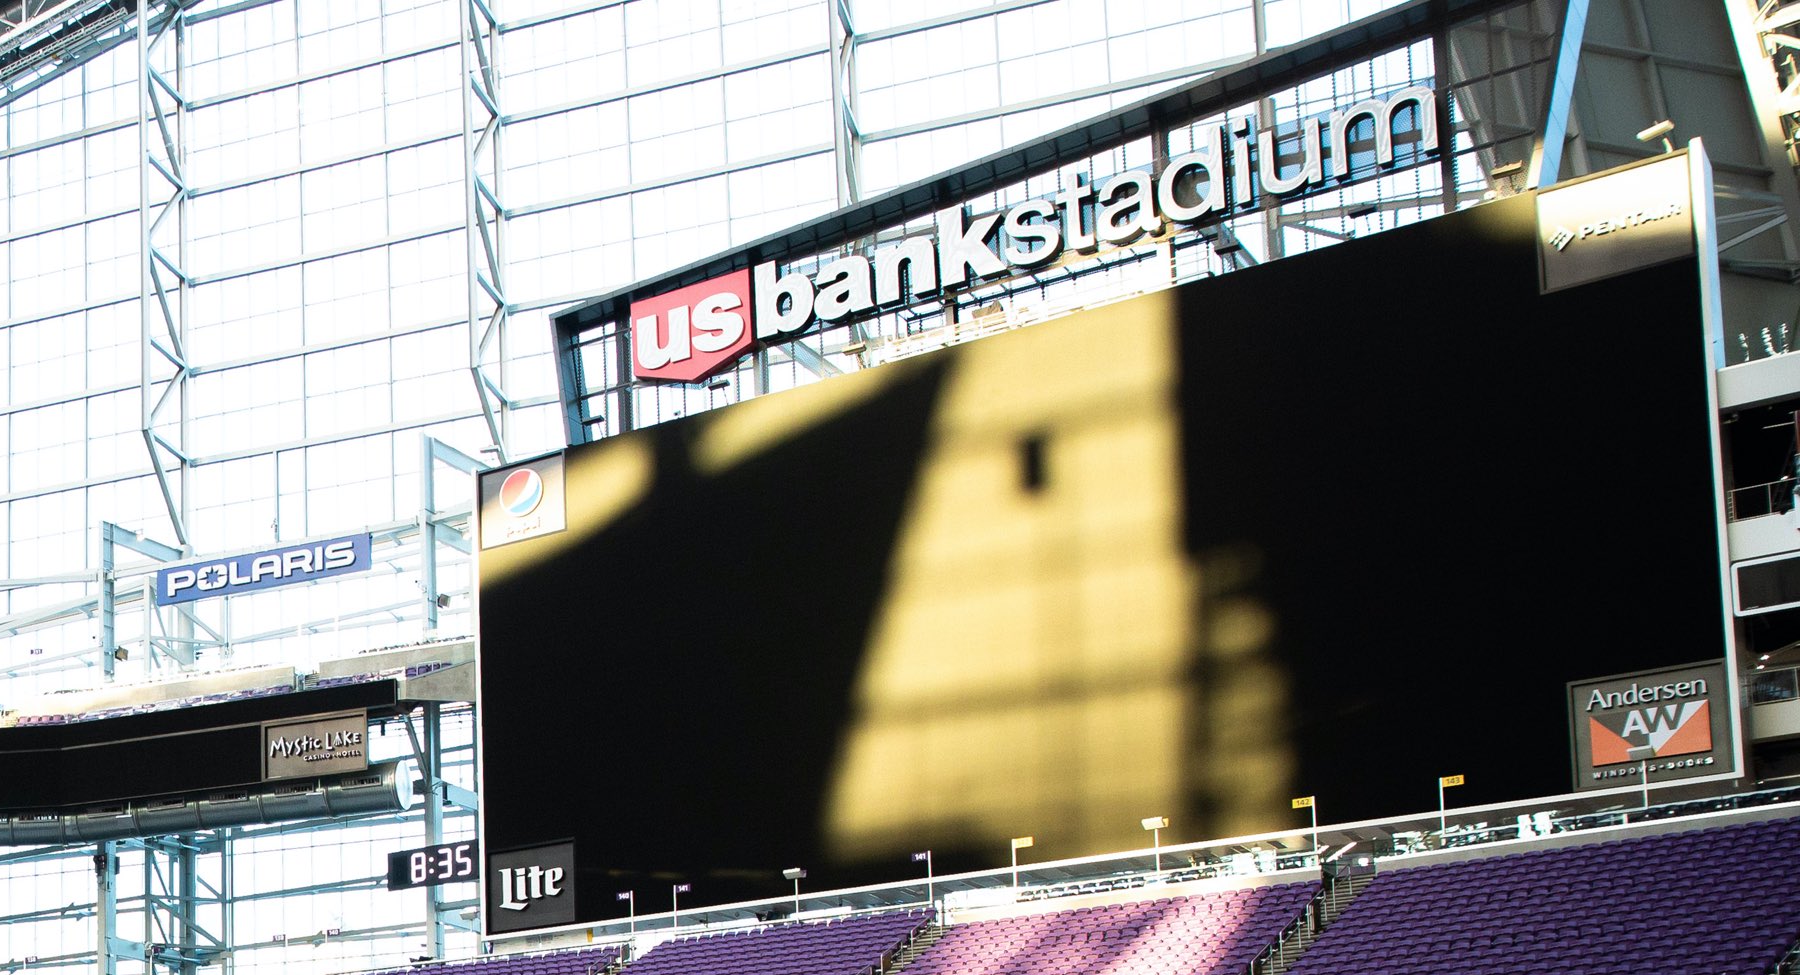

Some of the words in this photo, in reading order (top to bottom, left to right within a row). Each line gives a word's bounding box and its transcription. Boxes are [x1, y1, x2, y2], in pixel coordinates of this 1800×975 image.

[167, 540, 356, 597] POLARIS
[1586, 678, 1708, 712] Andersen
[303, 752, 331, 761] CASINO
[336, 749, 361, 757] HOTEL
[409, 844, 473, 884] 8:35
[498, 866, 564, 911] Lite
